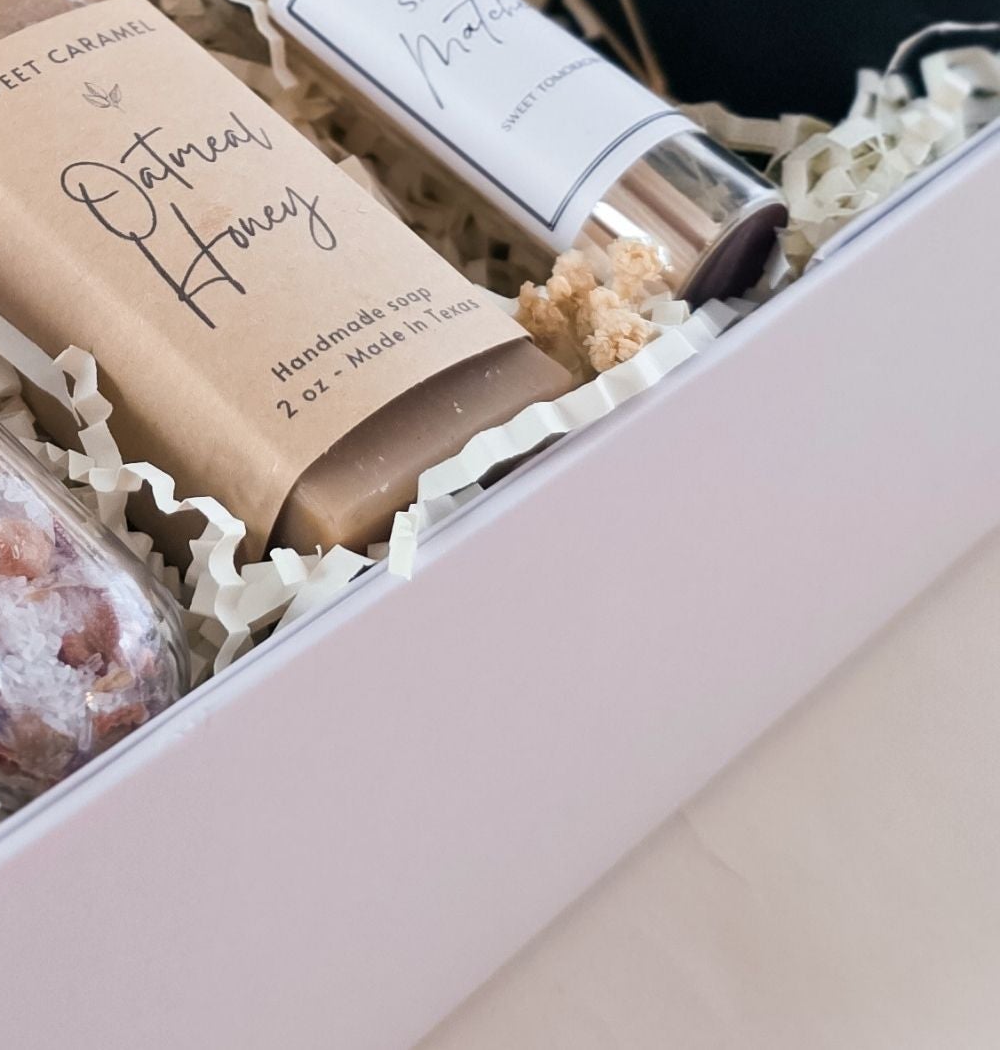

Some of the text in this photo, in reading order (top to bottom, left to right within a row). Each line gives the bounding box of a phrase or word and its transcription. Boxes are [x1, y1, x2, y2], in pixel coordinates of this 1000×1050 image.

[47, 19, 157, 64] CARAMEL
[501, 92, 538, 132] SWEET
[60, 111, 273, 241] Oatmeal
[129, 186, 337, 330] Honey
[271, 286, 433, 382] Handmade soap
[276, 399, 299, 419] 2
[302, 378, 330, 402] oz
[345, 331, 406, 369] Made
[424, 298, 481, 324] Texas
